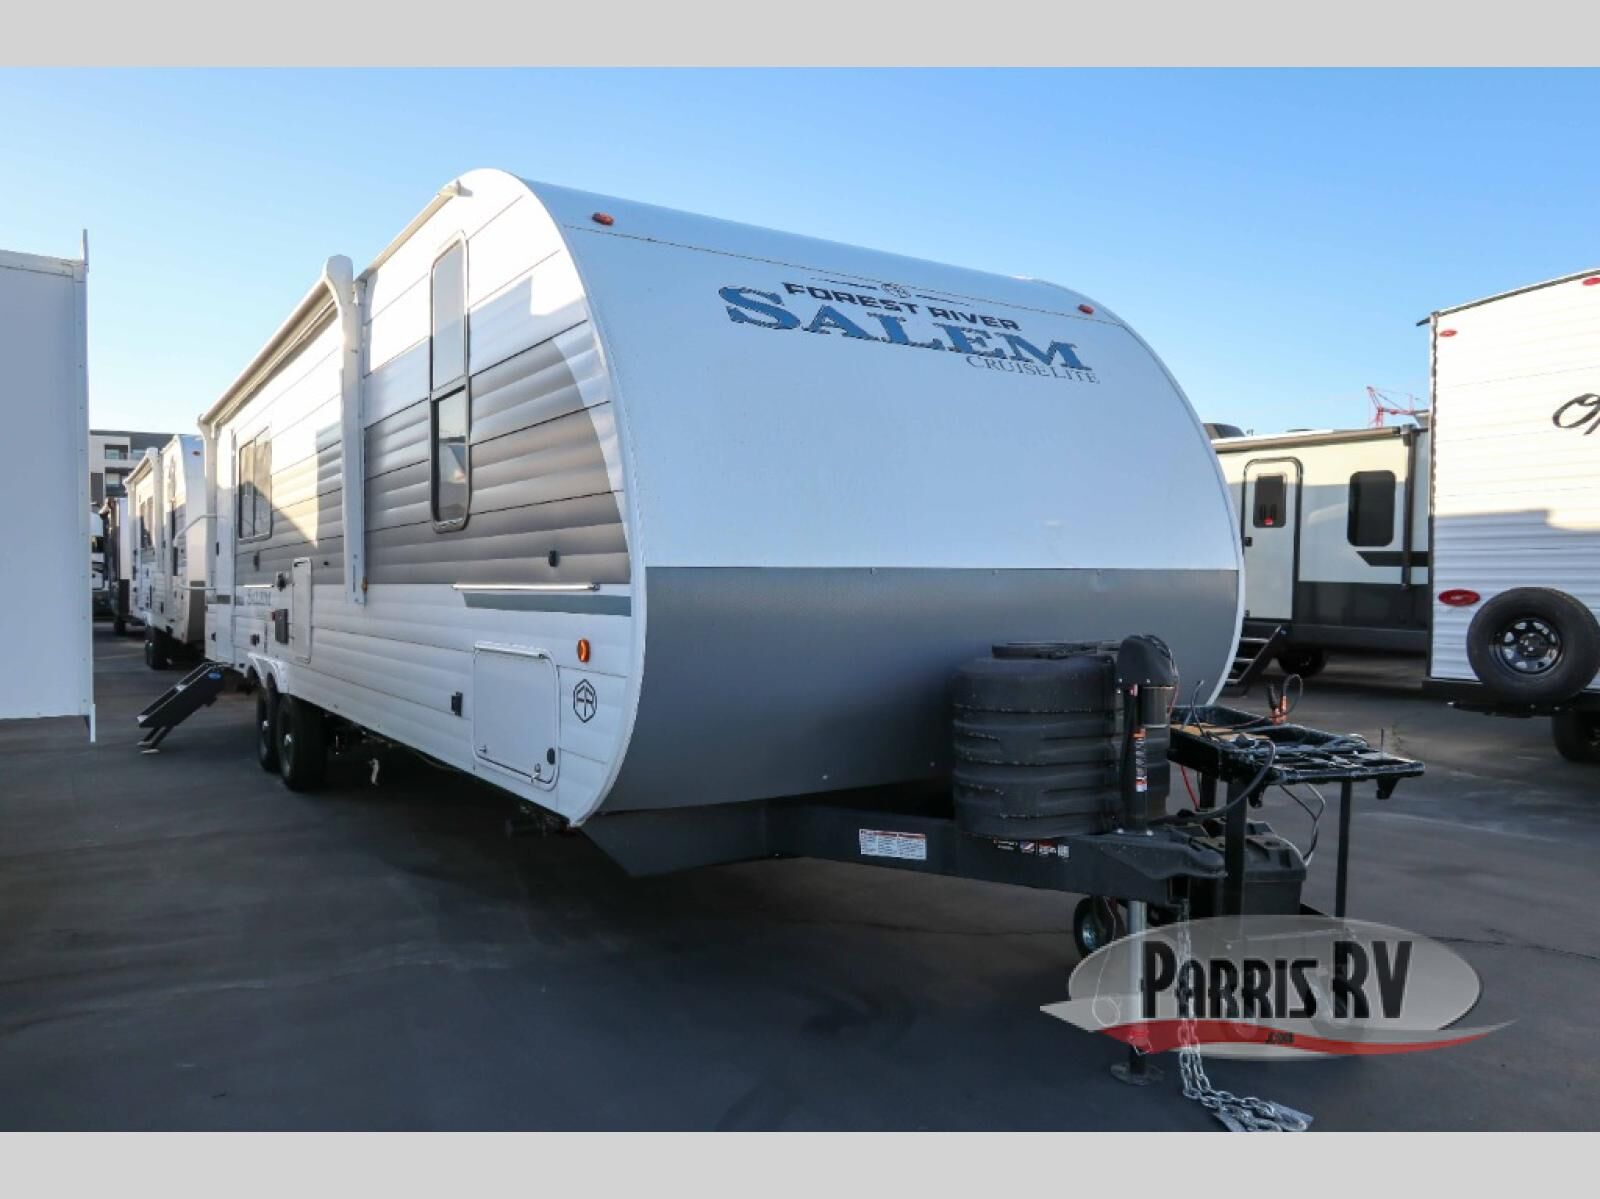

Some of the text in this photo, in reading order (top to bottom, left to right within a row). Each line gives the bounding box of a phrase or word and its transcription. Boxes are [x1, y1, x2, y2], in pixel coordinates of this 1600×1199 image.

[718, 285, 1093, 371] SALEM
[782, 282, 919, 314] FOREST
[927, 305, 1022, 331] RIVER
